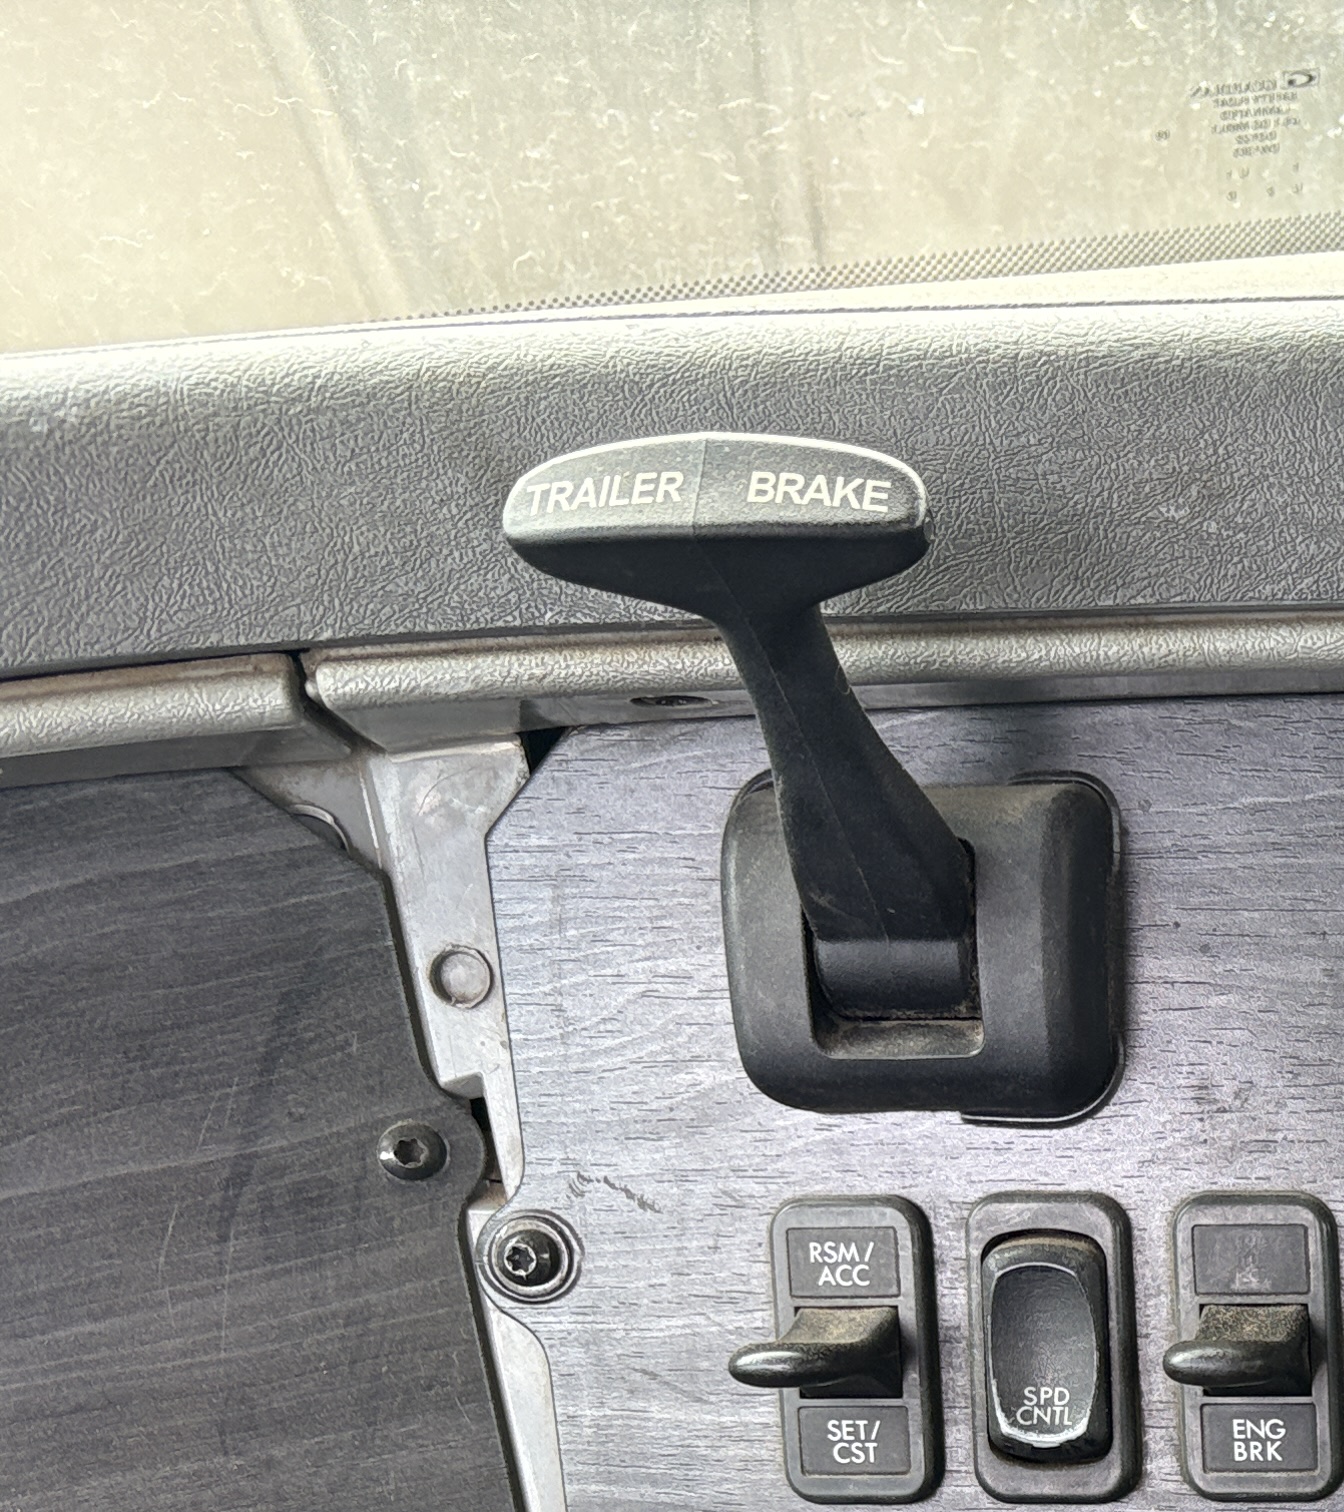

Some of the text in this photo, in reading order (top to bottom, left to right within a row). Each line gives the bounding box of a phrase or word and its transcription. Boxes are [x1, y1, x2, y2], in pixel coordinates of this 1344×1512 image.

[526, 470, 893, 516] TRAILER BRAKE
[818, 1264, 870, 1287] ACC
[1023, 1386, 1070, 1407] SPD
[1016, 1405, 1073, 1426] CNTL
[827, 1419, 880, 1443] SET/
[1232, 1419, 1286, 1440] ENG
[832, 1441, 878, 1464] CST
[1233, 1440, 1283, 1462] BRK
